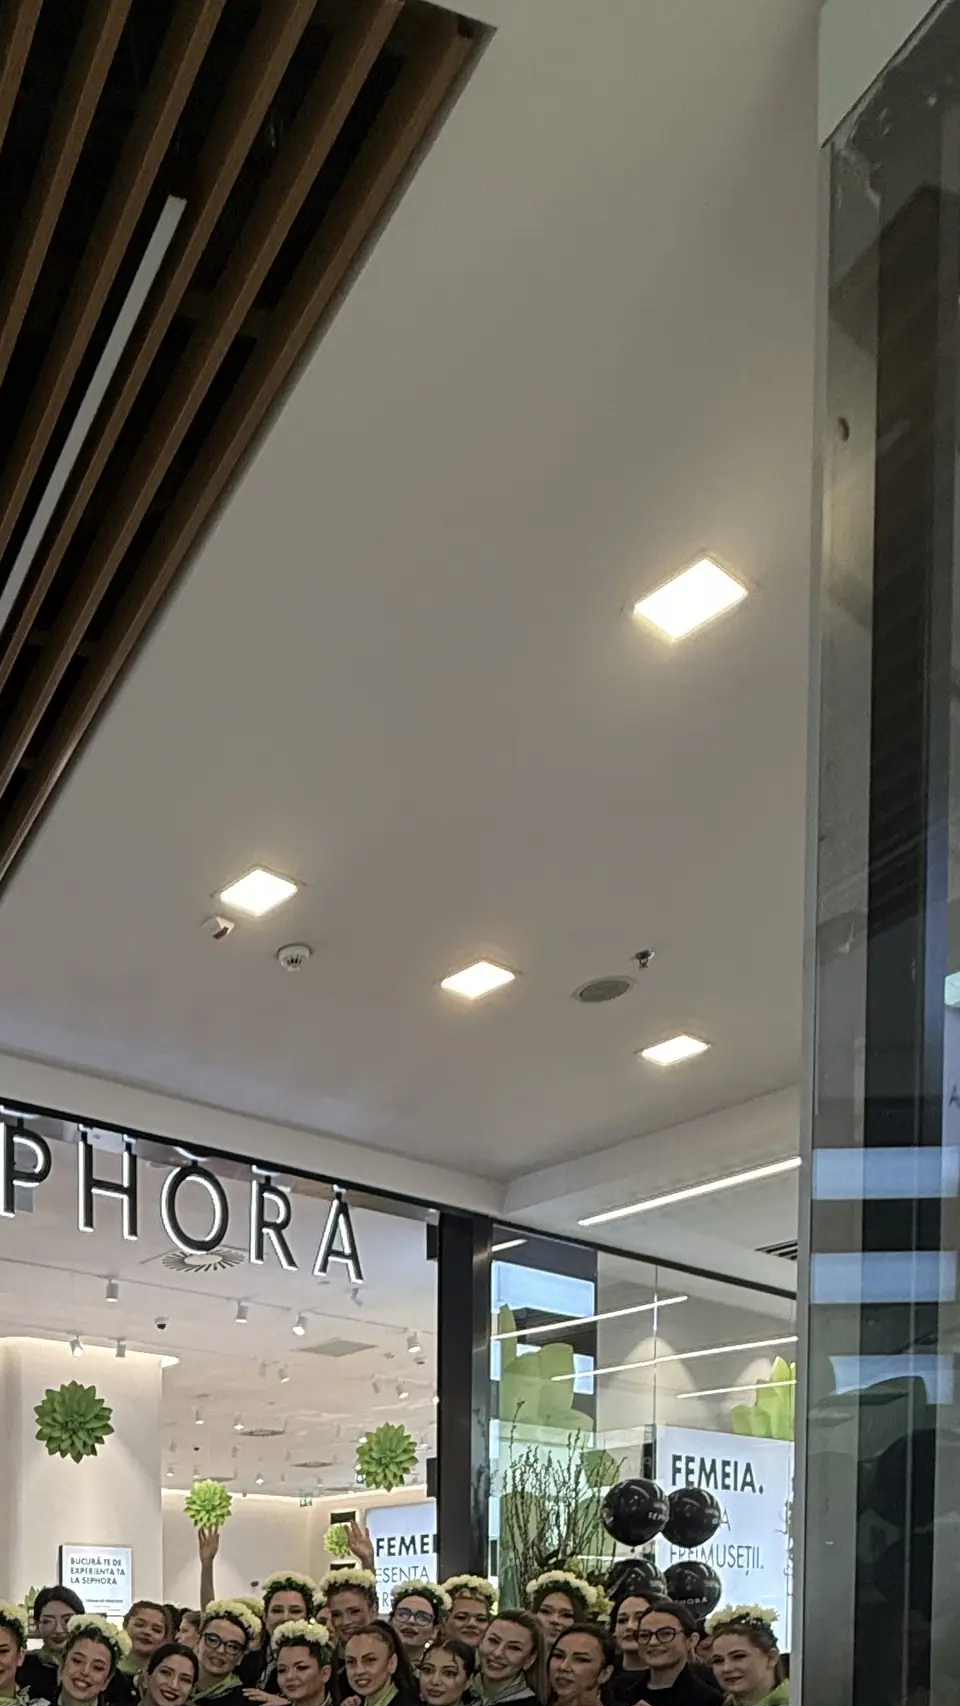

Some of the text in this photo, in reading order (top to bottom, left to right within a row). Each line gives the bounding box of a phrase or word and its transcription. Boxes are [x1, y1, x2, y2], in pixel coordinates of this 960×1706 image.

[671, 1454, 764, 1495] FEMEIA.
[376, 1534, 437, 1557] FEMEI
[81, 1577, 117, 1585] SEPHORA
